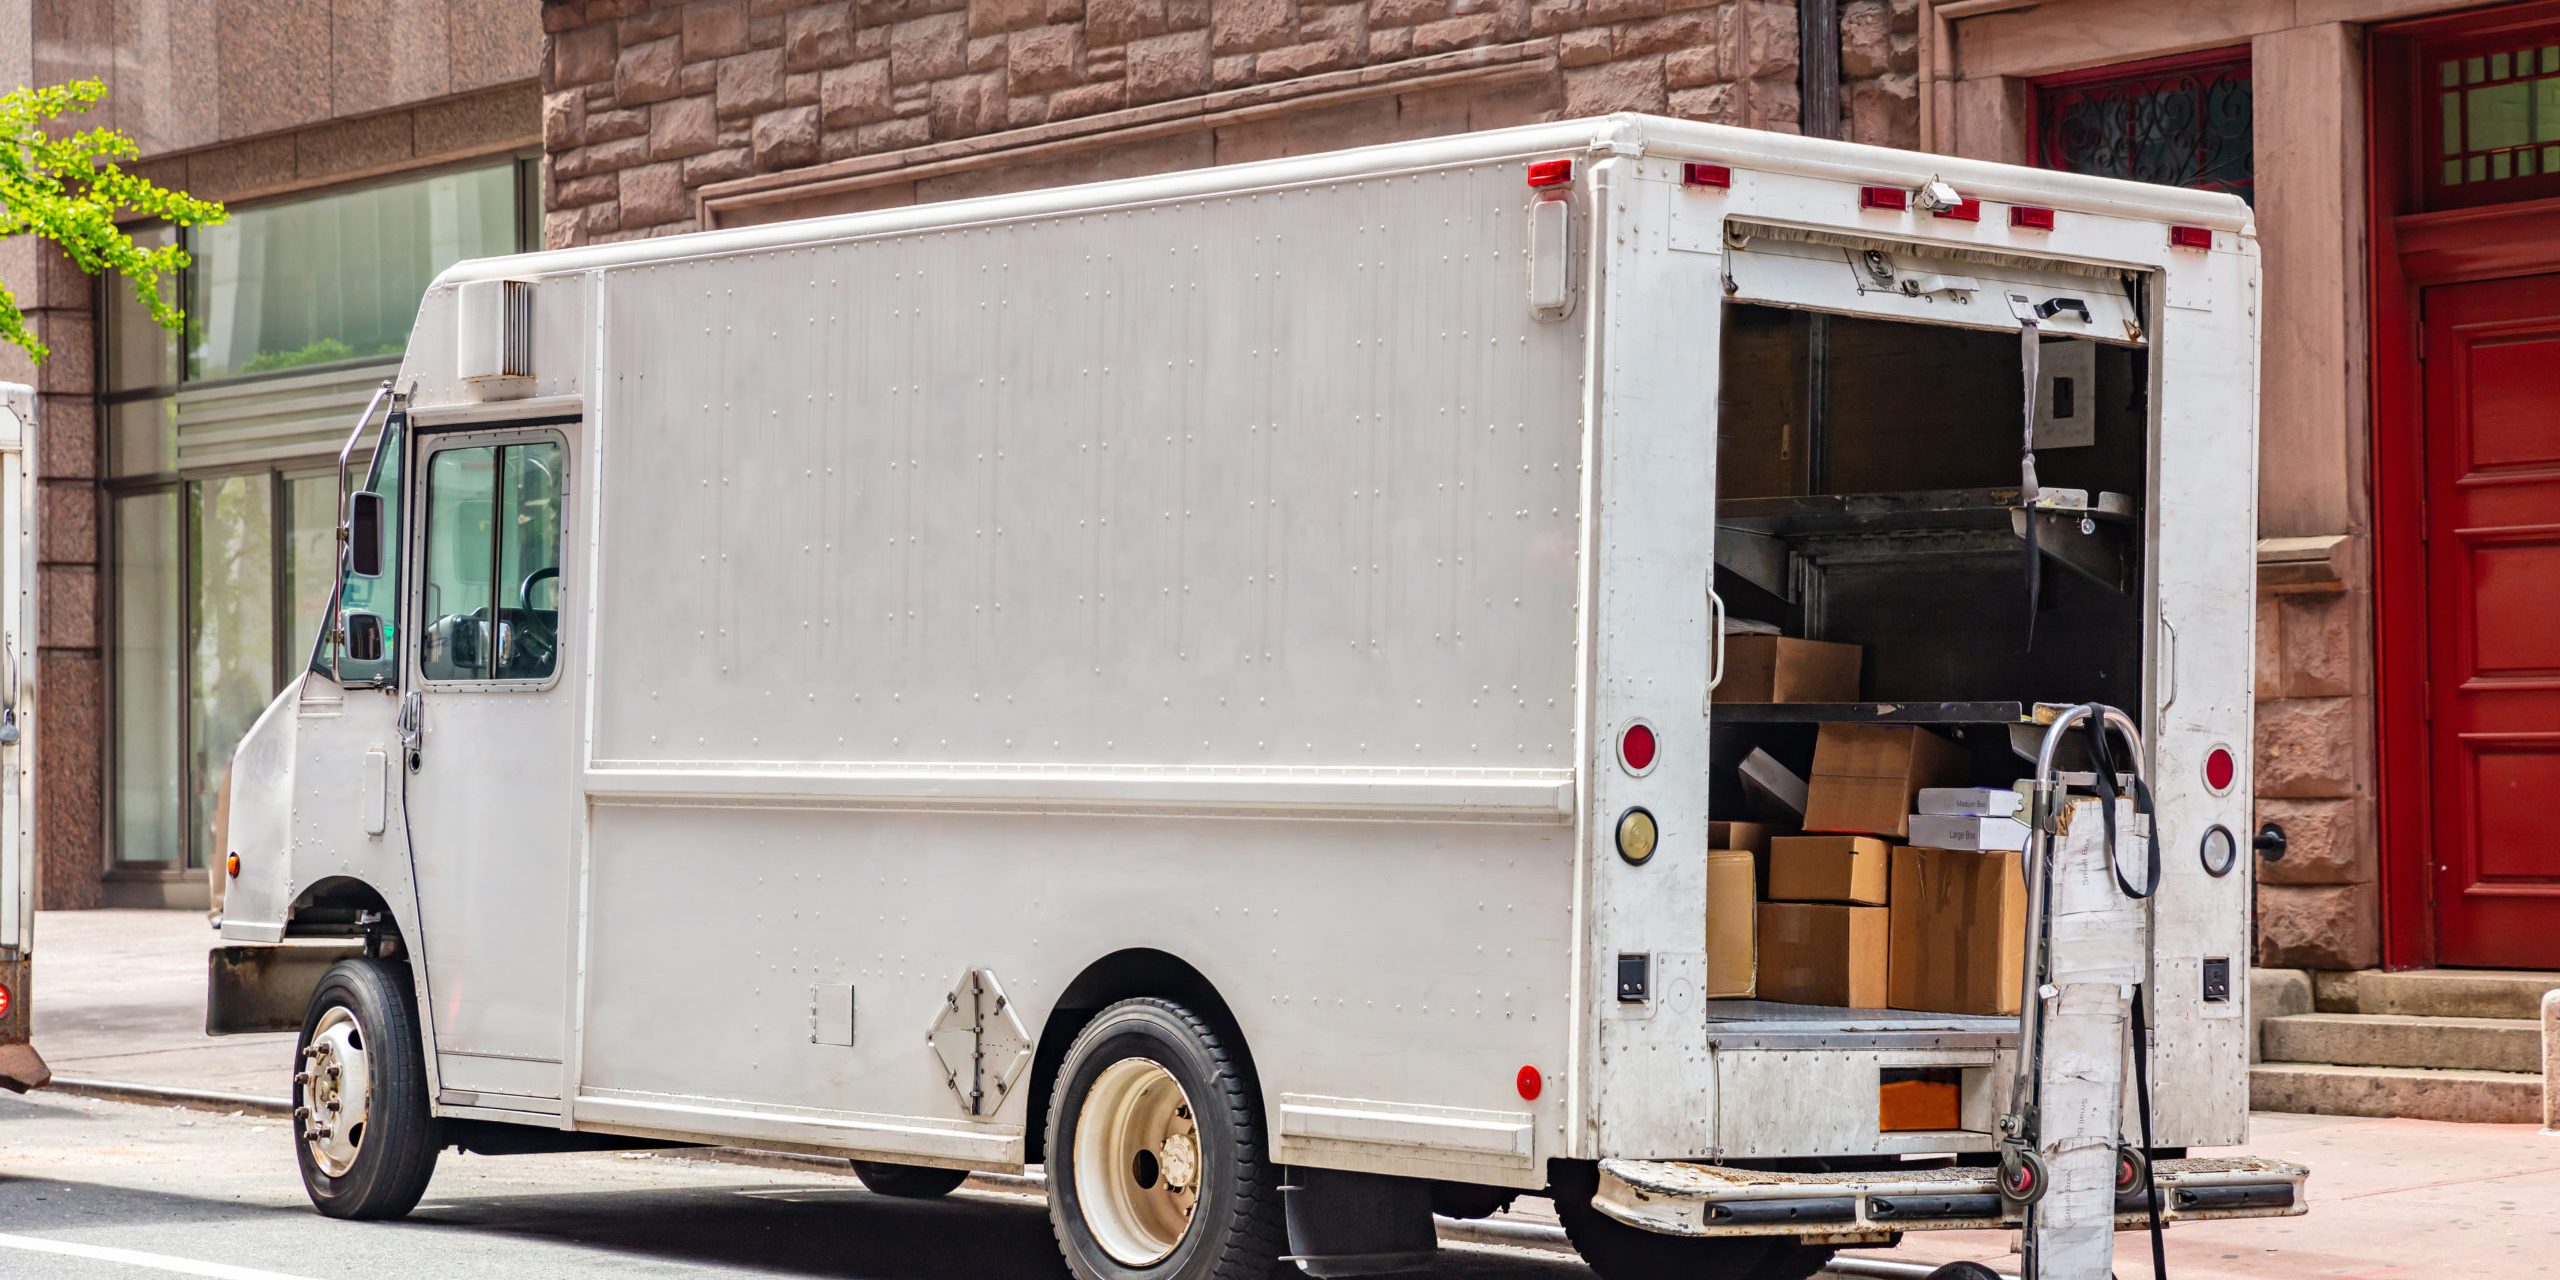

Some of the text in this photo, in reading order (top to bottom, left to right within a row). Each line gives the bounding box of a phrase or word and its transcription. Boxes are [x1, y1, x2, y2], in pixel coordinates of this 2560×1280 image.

[1956, 800, 1986, 808] Medium Box
[1950, 830, 1976, 840] Large Box
[2082, 838, 2090, 856] Box
[2079, 1097, 2088, 1124] Small
